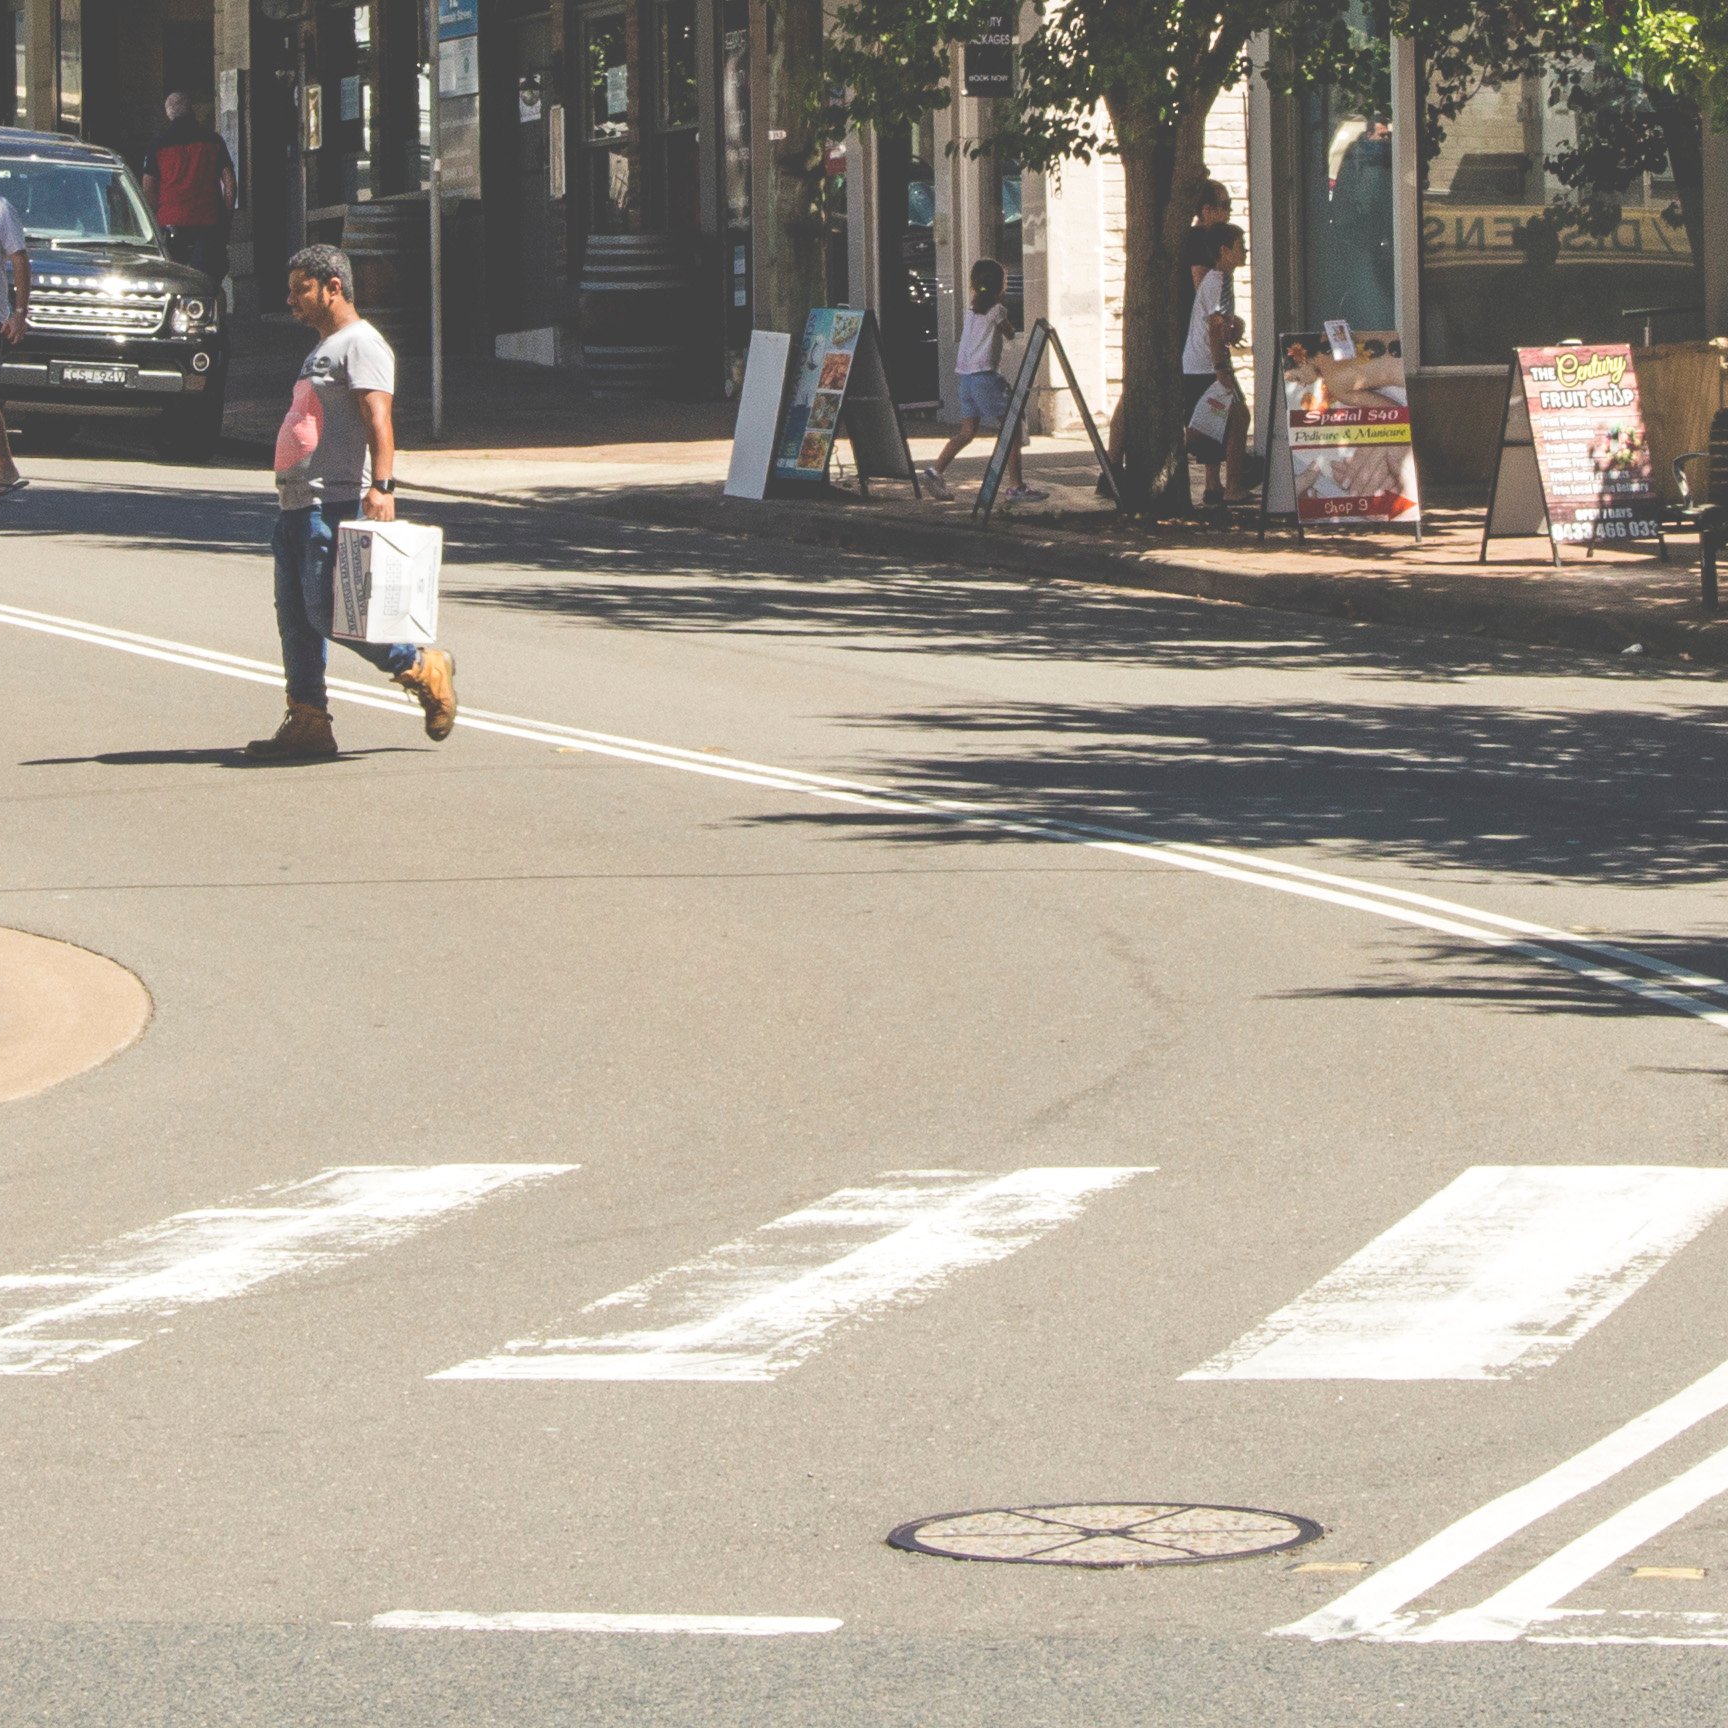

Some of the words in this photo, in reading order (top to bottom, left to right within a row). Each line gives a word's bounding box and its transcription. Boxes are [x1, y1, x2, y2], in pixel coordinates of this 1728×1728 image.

[968, 74, 989, 82] BOOK
[990, 74, 1009, 82] NOW
[1529, 367, 1557, 382] THE
[1555, 352, 1627, 388] Century
[1539, 390, 1588, 410] FRUIT
[1590, 383, 1635, 408] SHOP
[1303, 408, 1363, 426] Special
[1294, 429, 1340, 444] Pedicure
[1342, 428, 1353, 441] &
[1355, 425, 1407, 442] Manicure
[1324, 499, 1353, 516] Shop
[1609, 506, 1634, 519] DAYS
[1596, 521, 1627, 539] 466
